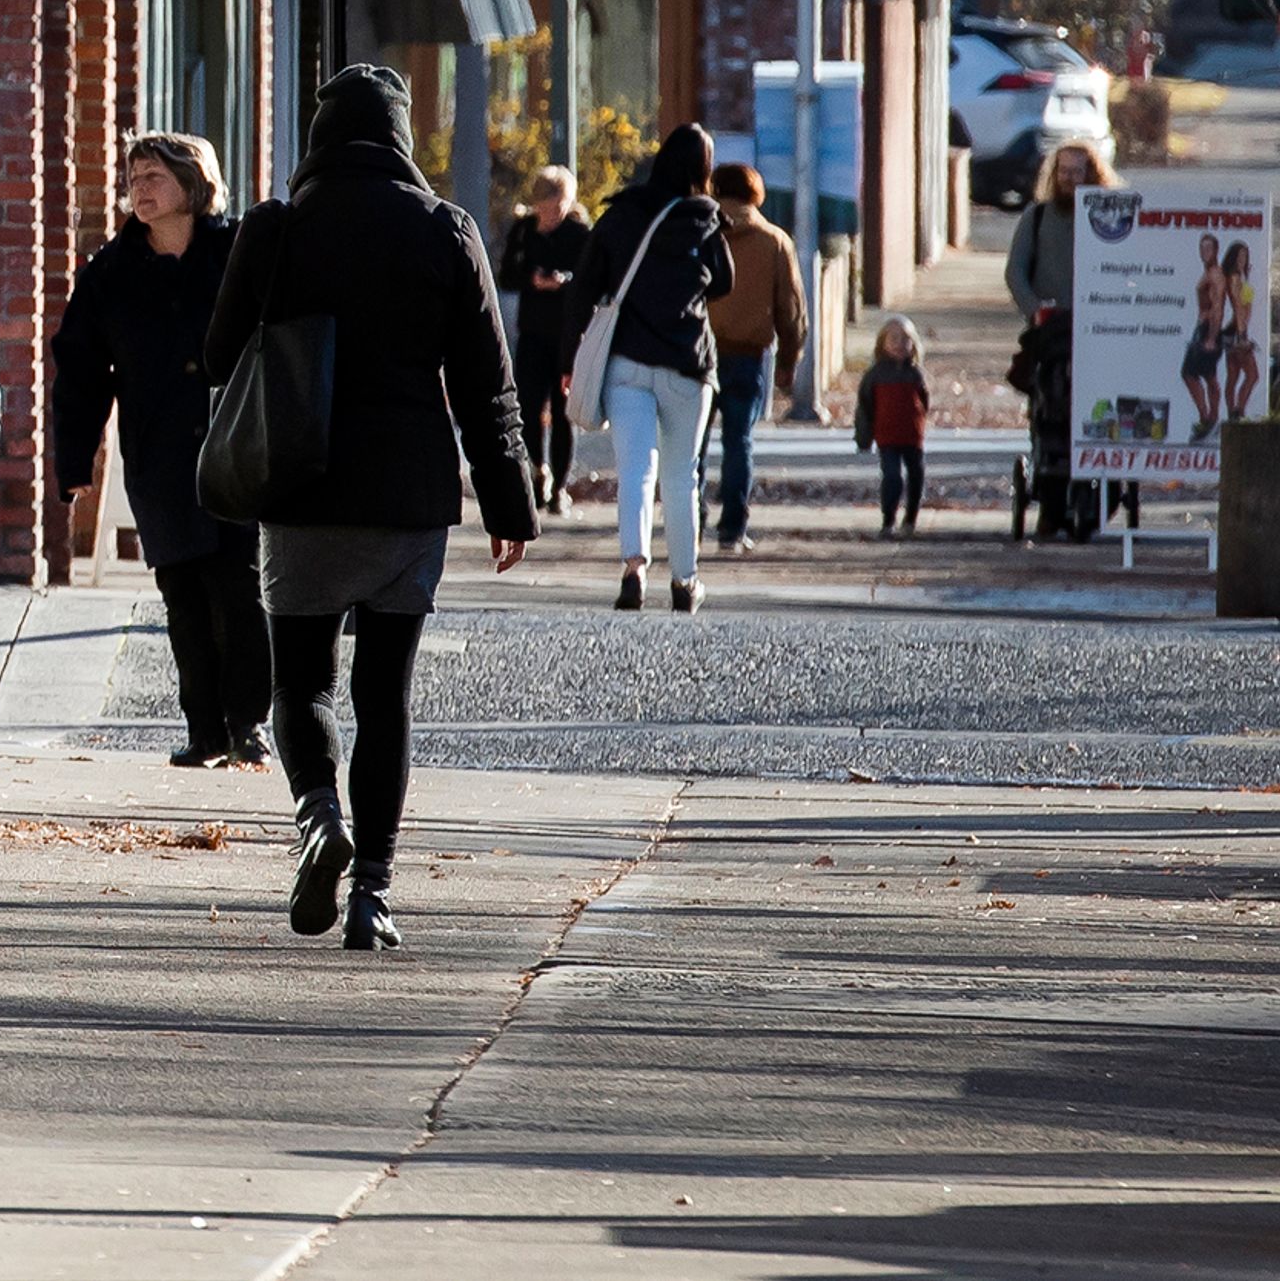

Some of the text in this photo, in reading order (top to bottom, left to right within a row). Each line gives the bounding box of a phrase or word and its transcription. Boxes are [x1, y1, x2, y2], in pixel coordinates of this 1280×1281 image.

[1138, 209, 1263, 231] NUTRITION
[1100, 261, 1143, 278] Weight
[1134, 291, 1186, 309] Building
[1078, 448, 1137, 469] FAST
